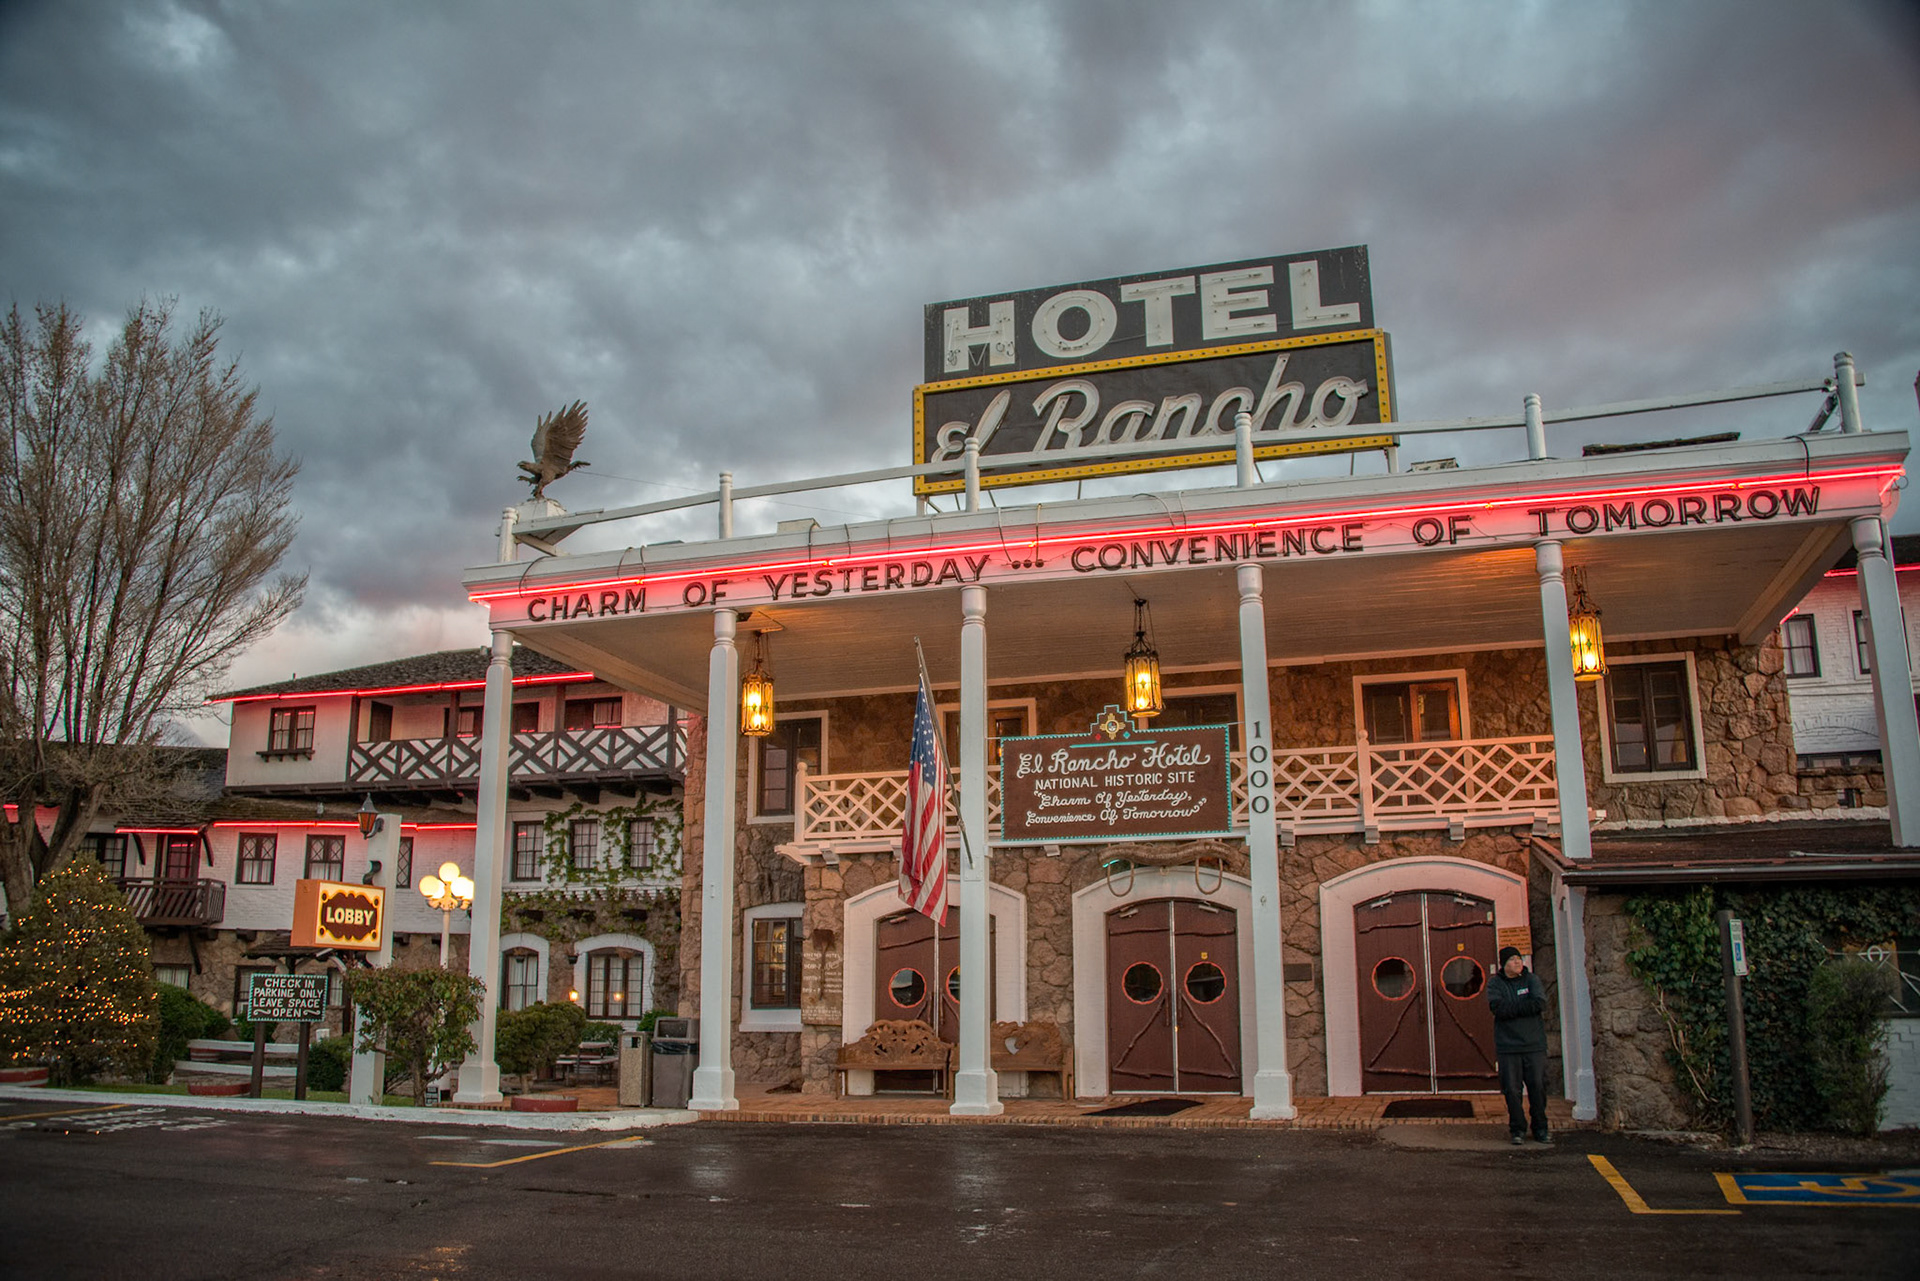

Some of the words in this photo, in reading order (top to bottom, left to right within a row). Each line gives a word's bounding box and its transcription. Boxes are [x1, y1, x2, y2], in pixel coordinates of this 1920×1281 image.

[943, 259, 1361, 373] HOTEL
[1032, 353, 1368, 453] Rancho
[527, 587, 647, 622] CHARM
[682, 579, 729, 607] OF
[763, 554, 990, 600] YESTERDAY
[1070, 523, 1363, 573] CONVENIENCE
[1412, 514, 1472, 546] OF
[1528, 486, 1821, 537] TOMORROW
[1016, 752, 1044, 779] El
[1047, 748, 1137, 775] Rancho
[1141, 742, 1211, 769] Hotel
[1249, 721, 1270, 813] 1000
[1035, 776, 1098, 790] NATIONAL
[1104, 773, 1163, 787] HISTORIC
[1167, 770, 1196, 783] SITE
[1095, 791, 1113, 809] Of
[1115, 788, 1192, 808] Yesterday,
[1025, 810, 1096, 827] Convenience
[1100, 807, 1118, 826] Of
[325, 906, 375, 926] LOBBY
[253, 987, 296, 998] PARKING
[300, 988, 324, 998] ONLY
[264, 977, 302, 988] CHECK
[304, 979, 316, 989] IN
[252, 997, 284, 1008] LEAVE
[287, 998, 321, 1009] SPACE
[272, 1008, 302, 1018] OPEN
